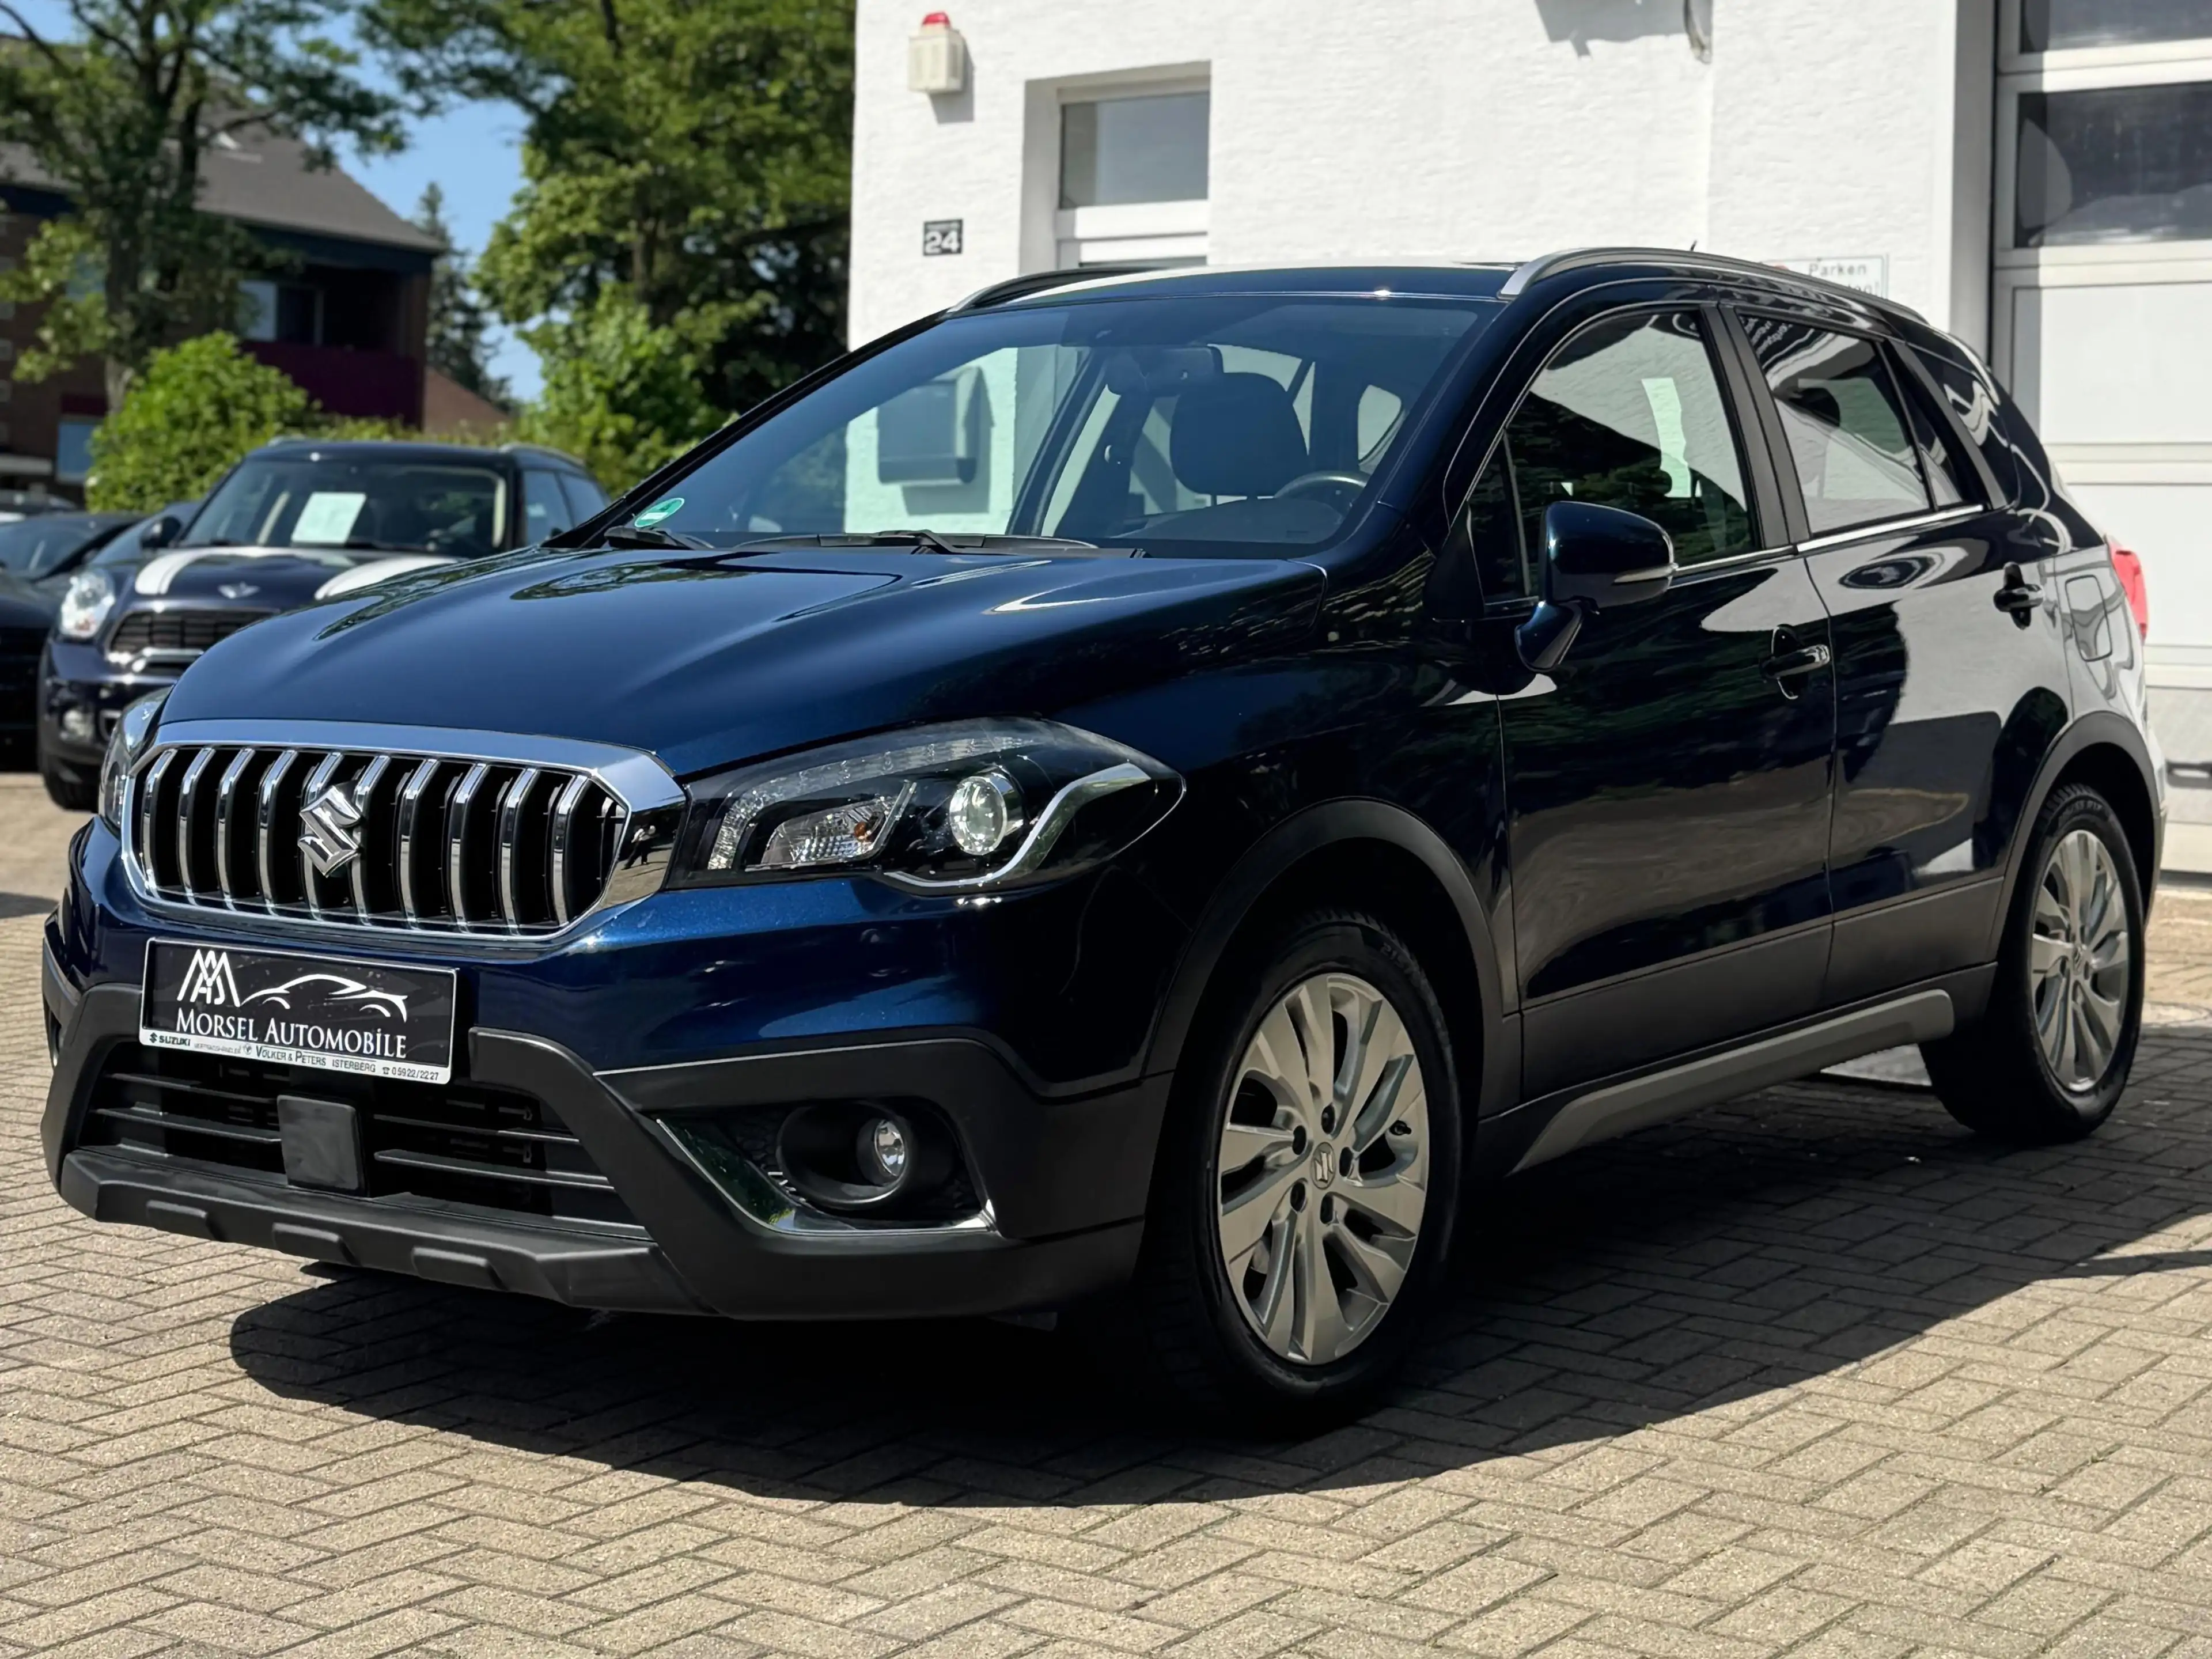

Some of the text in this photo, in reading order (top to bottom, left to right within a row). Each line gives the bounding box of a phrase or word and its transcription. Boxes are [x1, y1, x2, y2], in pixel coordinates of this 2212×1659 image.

[926, 230, 960, 253] 24
[1809, 263, 1866, 276] Parken
[176, 1007, 259, 1041] MORSEL
[159, 1035, 191, 1047] SUZUKI
[288, 1053, 293, 1062] &
[295, 1050, 327, 1066] PETERS
[332, 1059, 376, 1073] ISTERBERG
